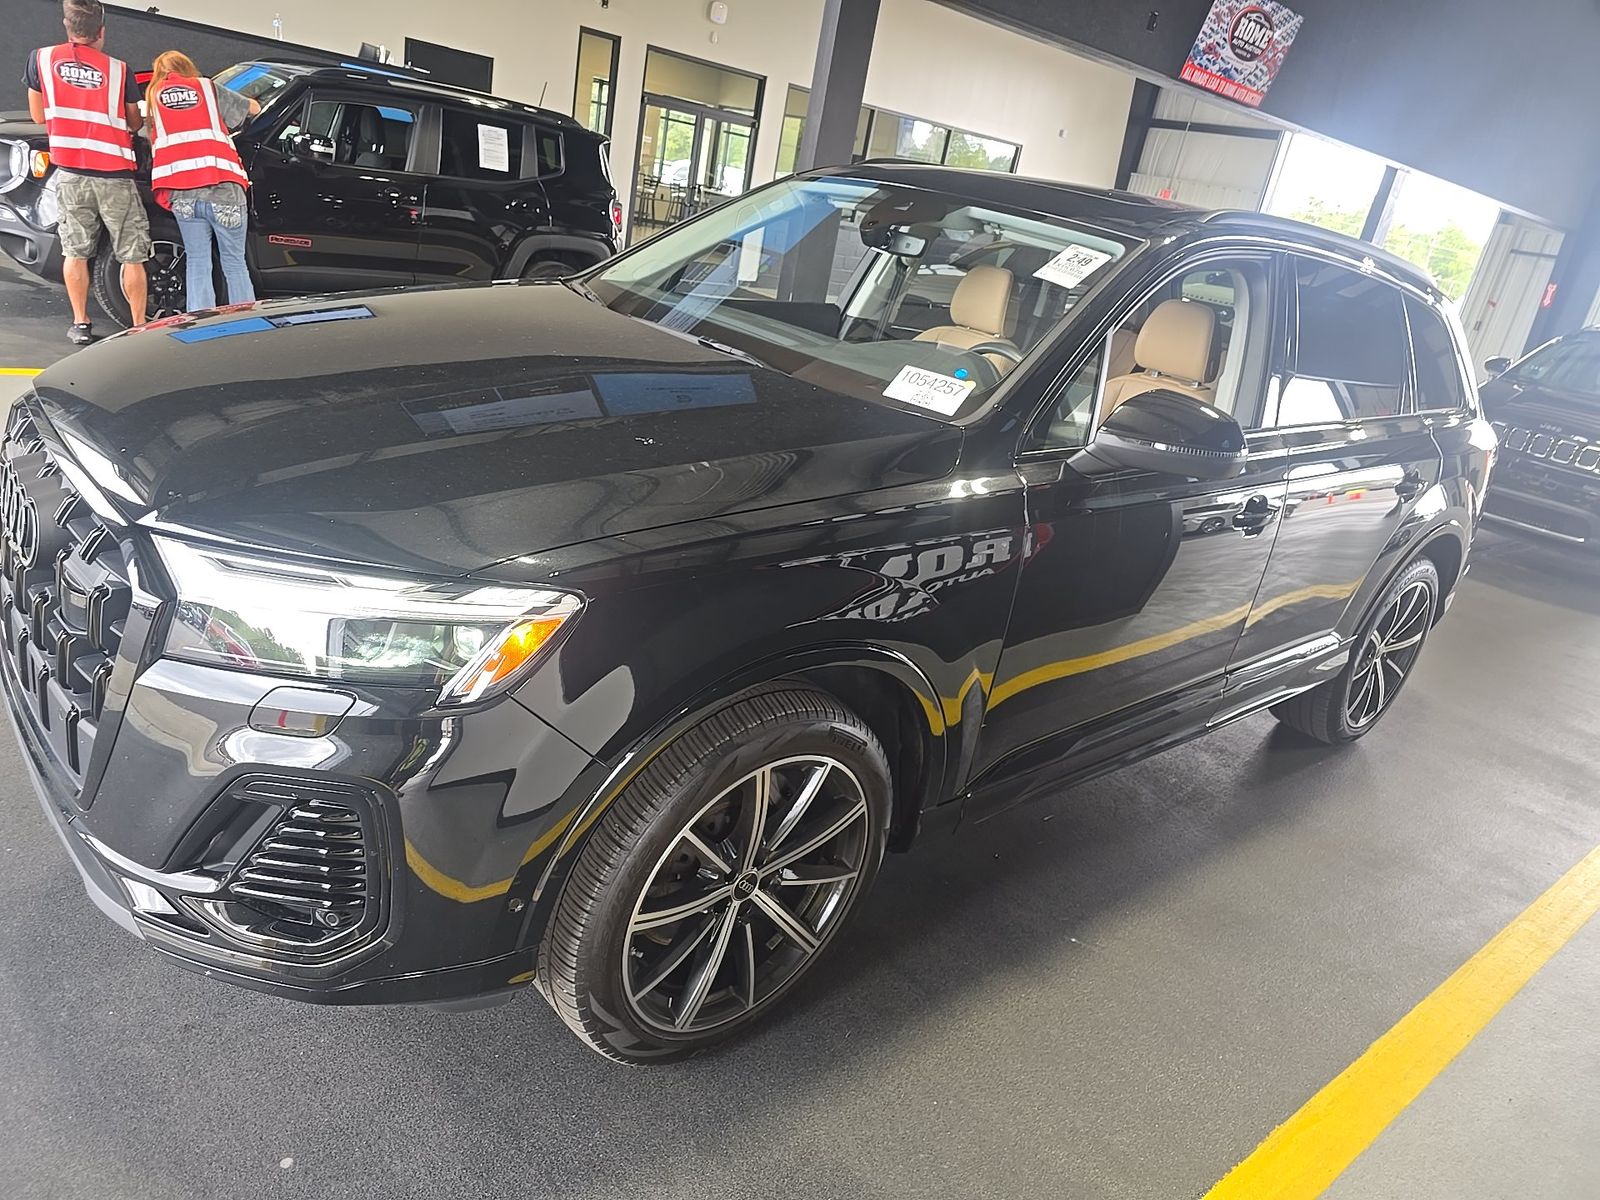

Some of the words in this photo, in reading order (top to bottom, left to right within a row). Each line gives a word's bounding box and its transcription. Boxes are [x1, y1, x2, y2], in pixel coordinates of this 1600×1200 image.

[1233, 17, 1274, 49] ROME
[60, 65, 103, 82] ROME
[161, 90, 198, 104] ROME
[902, 370, 966, 396] 1054257
